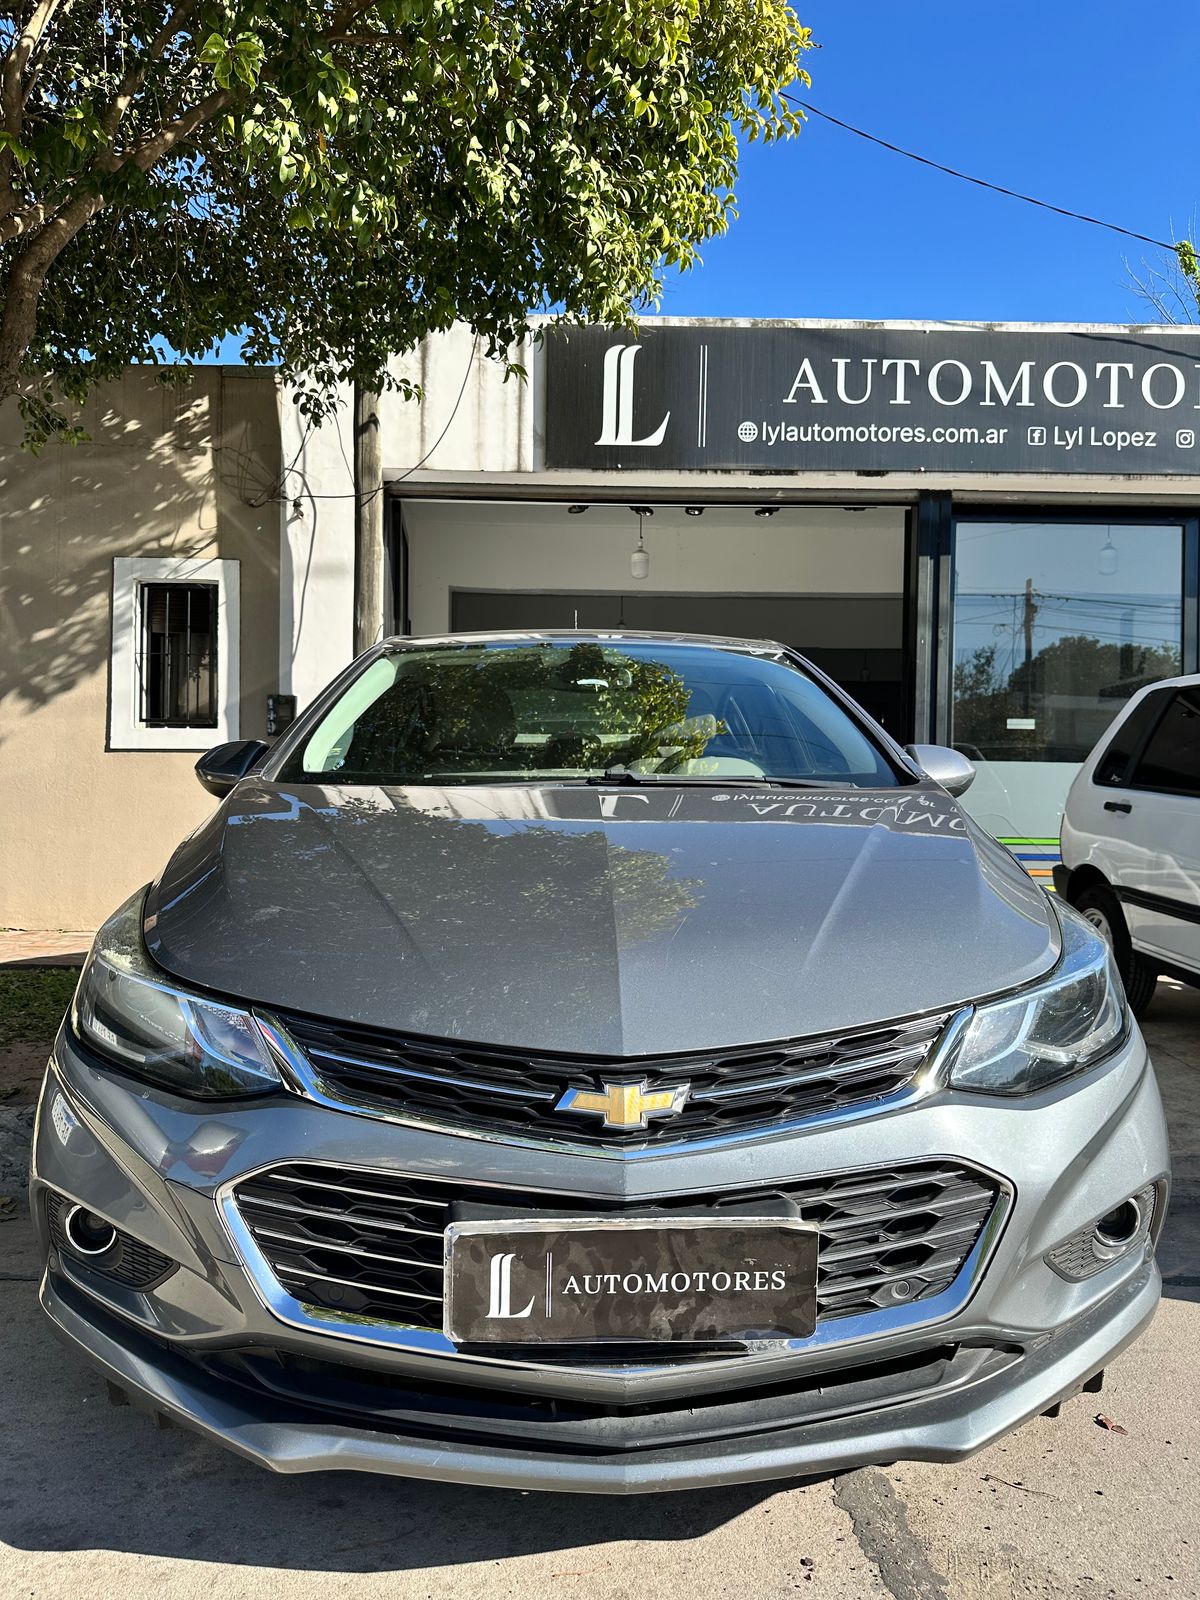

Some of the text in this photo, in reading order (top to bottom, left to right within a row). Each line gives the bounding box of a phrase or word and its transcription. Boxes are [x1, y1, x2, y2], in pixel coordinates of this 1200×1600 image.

[782, 357, 1200, 410] AUTOMOTO
[762, 421, 1009, 446] lylautomotores.com.ar
[1053, 425, 1084, 451] Lyl
[1090, 426, 1158, 451] Lopez
[561, 1269, 787, 1295] AUTOMOTORES
